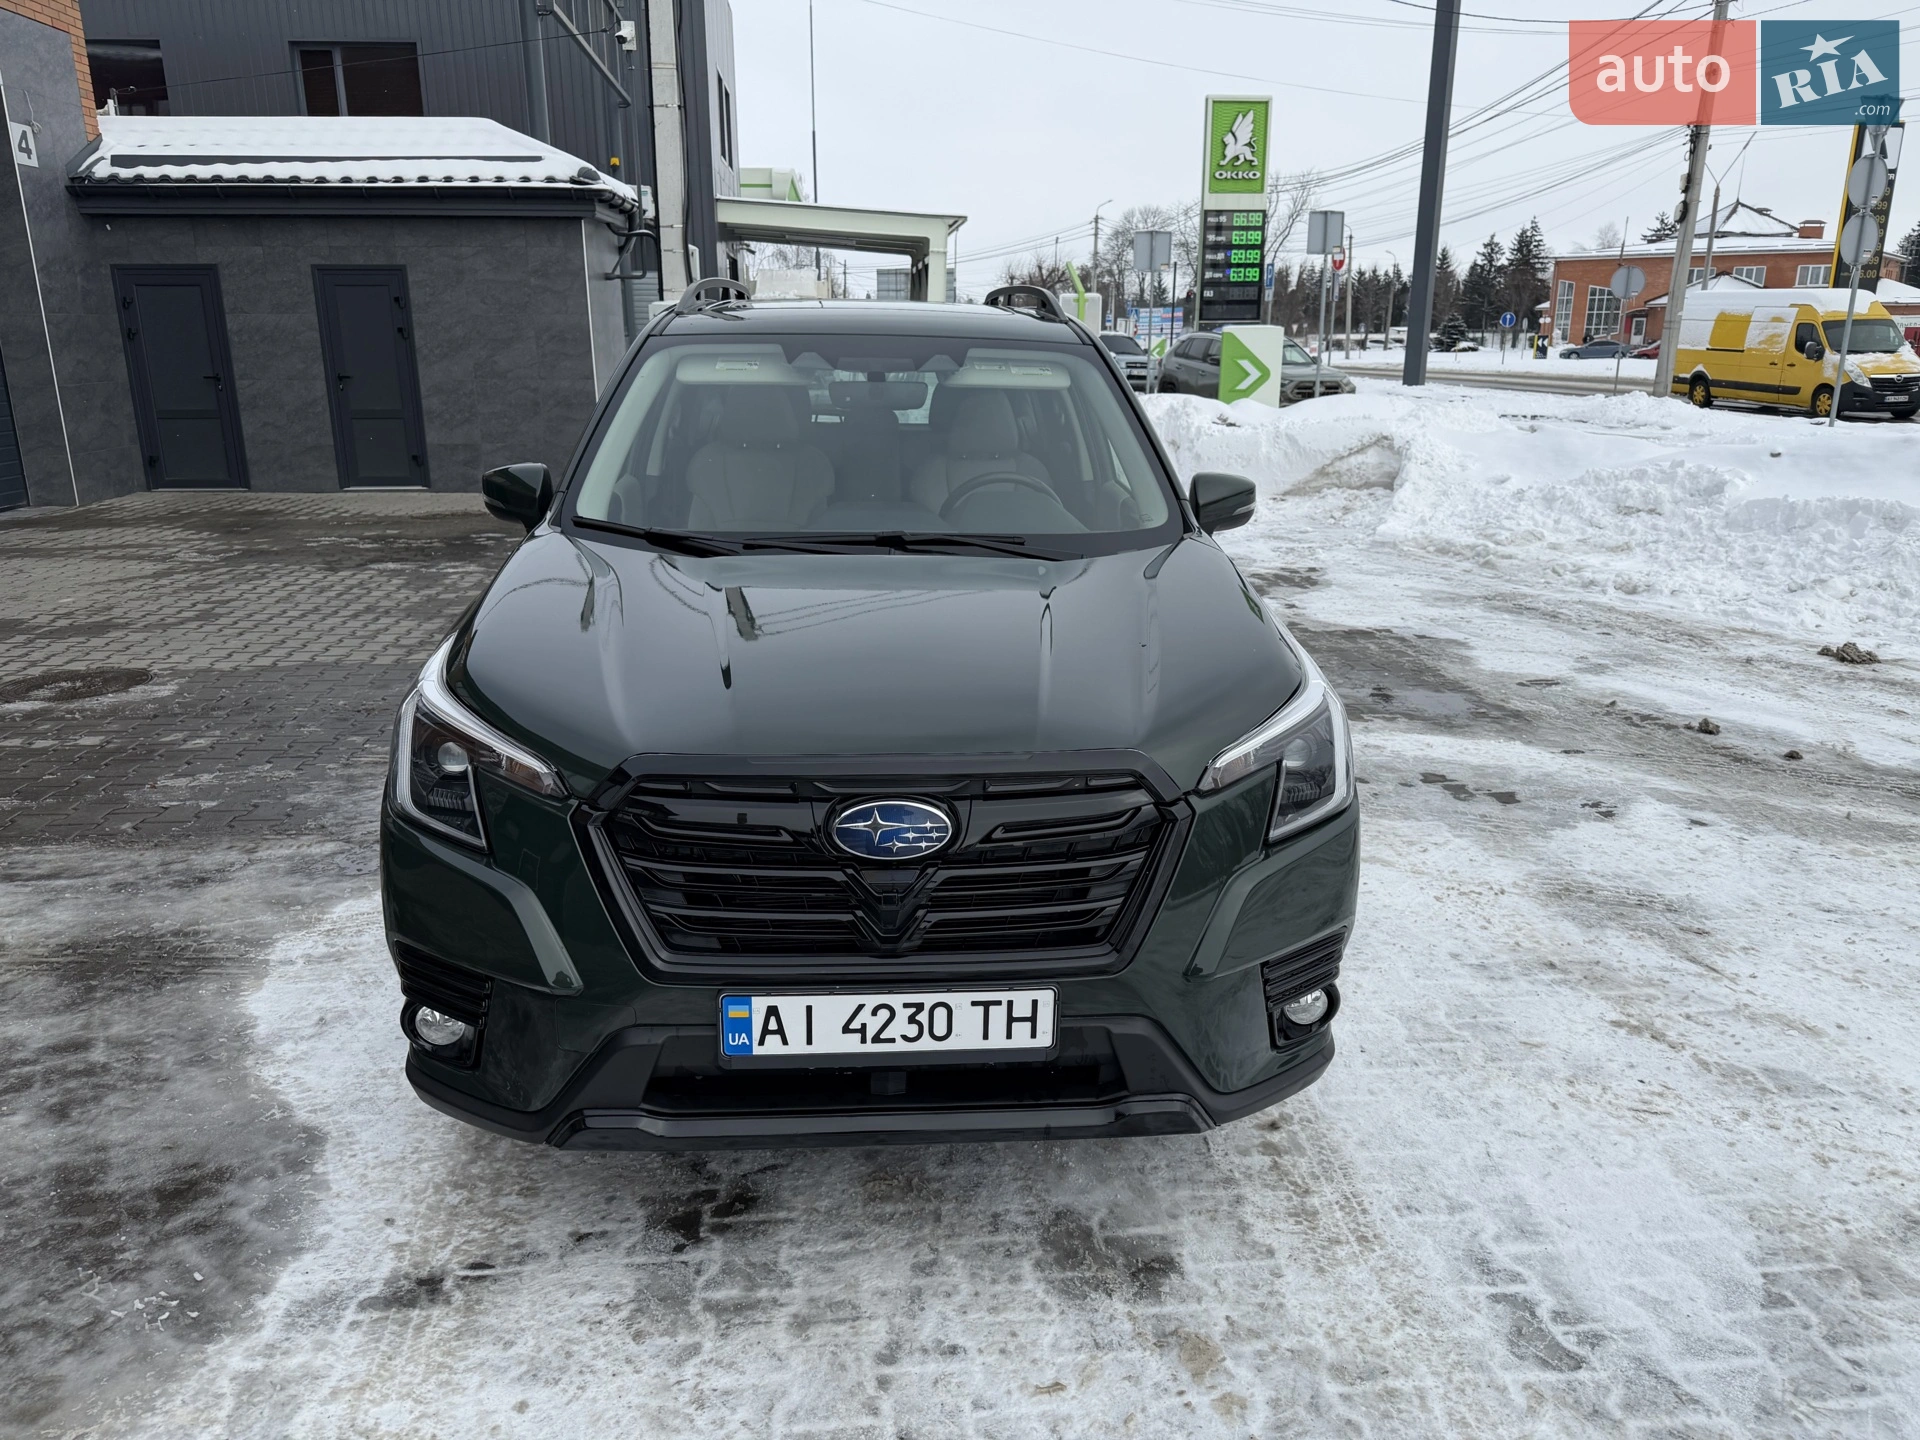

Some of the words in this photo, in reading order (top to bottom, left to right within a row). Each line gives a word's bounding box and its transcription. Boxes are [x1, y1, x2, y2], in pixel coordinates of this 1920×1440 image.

[17, 129, 33, 160] 4
[1214, 170, 1261, 180] OKKO
[1233, 212, 1263, 227] 66.99
[1232, 230, 1262, 245] 63.99
[1231, 249, 1261, 264] 69.99
[1230, 267, 1260, 282] 63.99
[758, 1004, 813, 1047] AI
[841, 1001, 954, 1045] 4230
[970, 998, 1039, 1041] TH
[728, 1033, 749, 1046] UA
